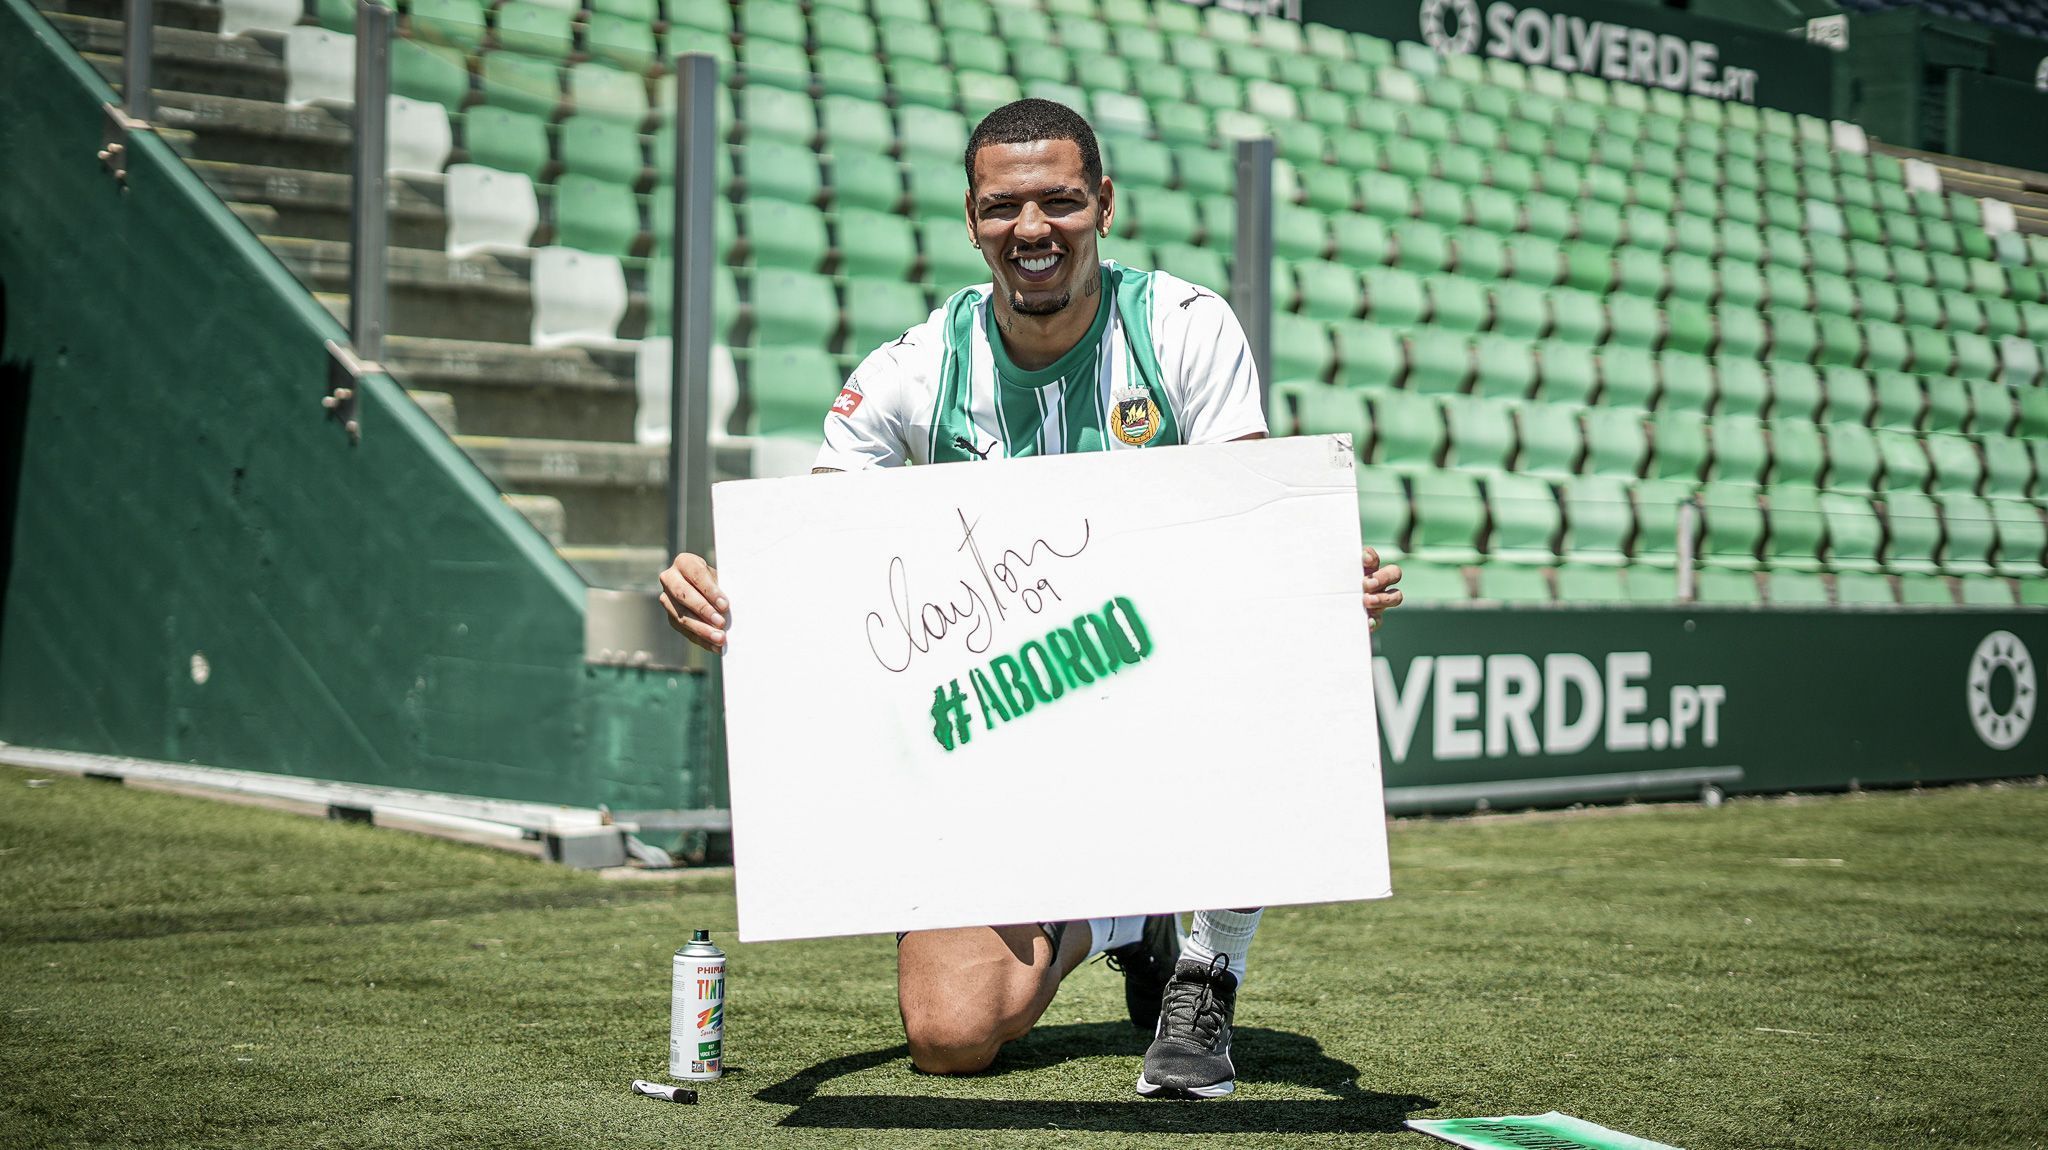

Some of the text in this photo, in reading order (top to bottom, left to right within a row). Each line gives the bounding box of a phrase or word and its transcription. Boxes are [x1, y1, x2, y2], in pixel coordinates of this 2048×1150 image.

[1485, 1, 1758, 101] SOLVERDE.PT
[866, 508, 1089, 672] Clayton
[1022, 579, 1061, 613] 09
[930, 596, 1152, 751] #ABORDO
[697, 966, 725, 974] PHIMA
